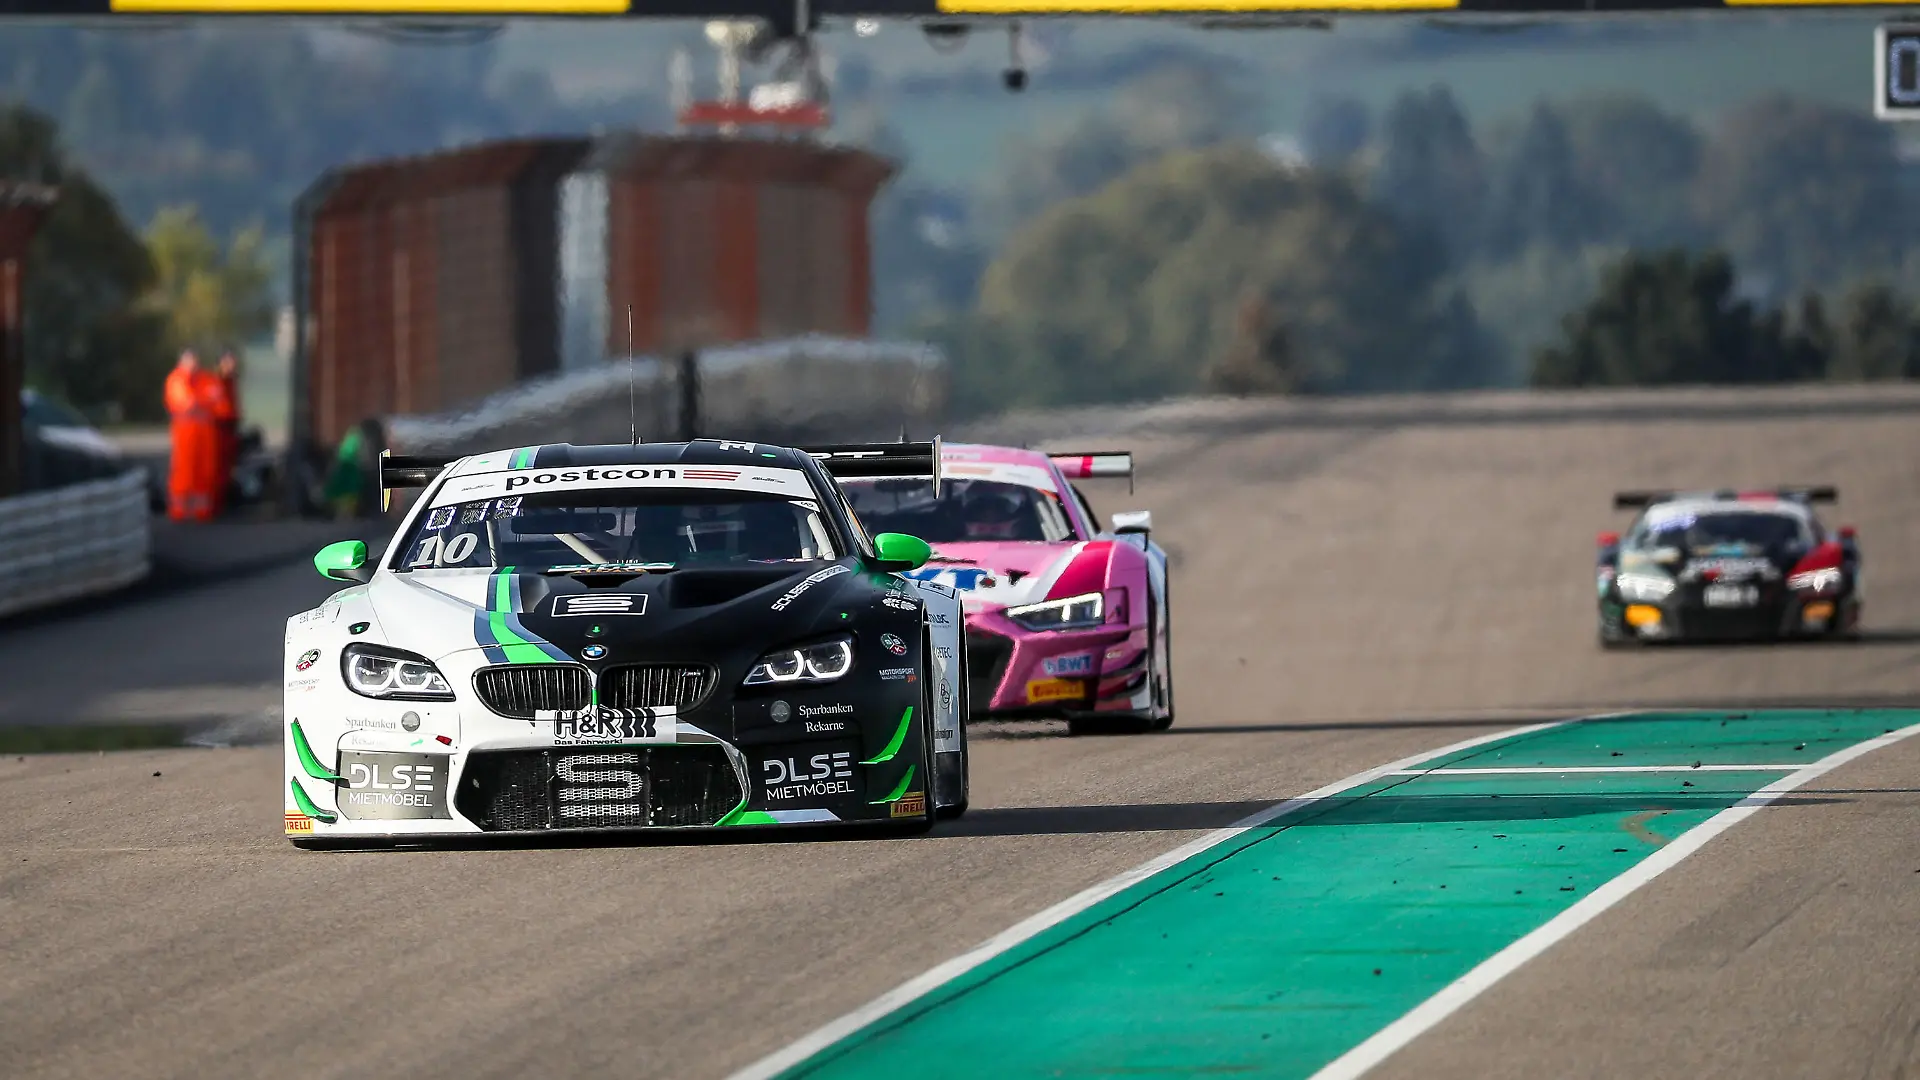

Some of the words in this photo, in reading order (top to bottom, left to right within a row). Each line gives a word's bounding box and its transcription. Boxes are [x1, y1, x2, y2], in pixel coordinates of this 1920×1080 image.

[506, 468, 676, 490] postcon
[409, 532, 478, 566] 10
[799, 703, 853, 717] Sparbanken
[345, 716, 396, 730] Sparbanken
[555, 707, 621, 738] H&R
[806, 721, 844, 732] Rekarne
[350, 763, 434, 791] DLSE
[763, 752, 852, 785] DLSE
[348, 791, 433, 807] MIETMÖBEL
[766, 781, 854, 801] MIETMÖBEL
[285, 820, 311, 830] IRELLI
